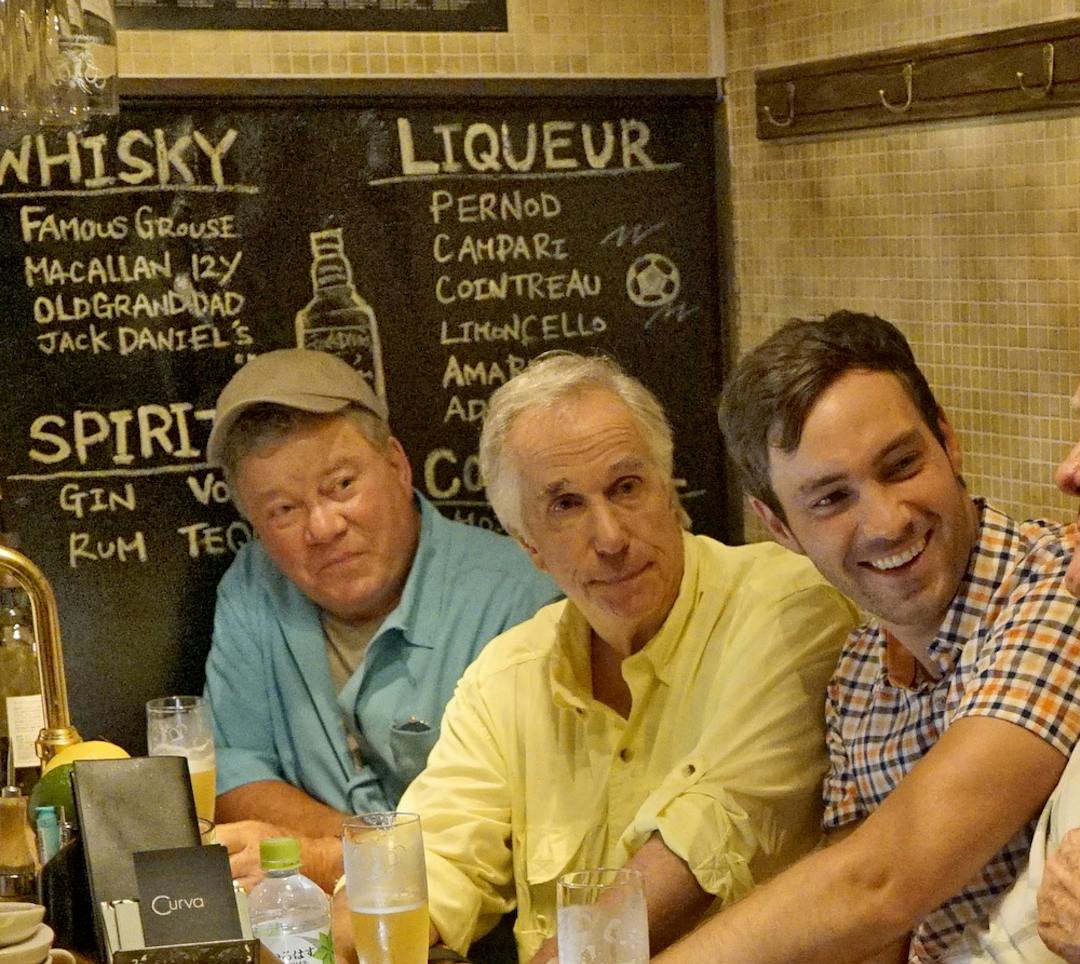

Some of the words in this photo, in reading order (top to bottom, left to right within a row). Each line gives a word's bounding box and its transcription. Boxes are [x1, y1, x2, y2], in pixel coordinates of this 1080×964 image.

[0, 128, 238, 188] WHISKY
[397, 117, 657, 176] LIQUEUR
[20, 205, 128, 242] FAMOUS
[135, 205, 239, 240] GROUSE
[428, 189, 561, 224] PERNOD
[433, 233, 568, 265] CAMPARI
[25, 251, 172, 287] MACALLAN
[191, 251, 243, 286] 12Y
[435, 269, 601, 304] COINTREAU
[37, 324, 112, 354] JACK
[118, 320, 254, 356] DANIEL'S
[440, 312, 607, 346] LIMONCELLO
[60, 483, 136, 518] GIN
[69, 531, 148, 568] RUM
[152, 895, 204, 915] Curva
